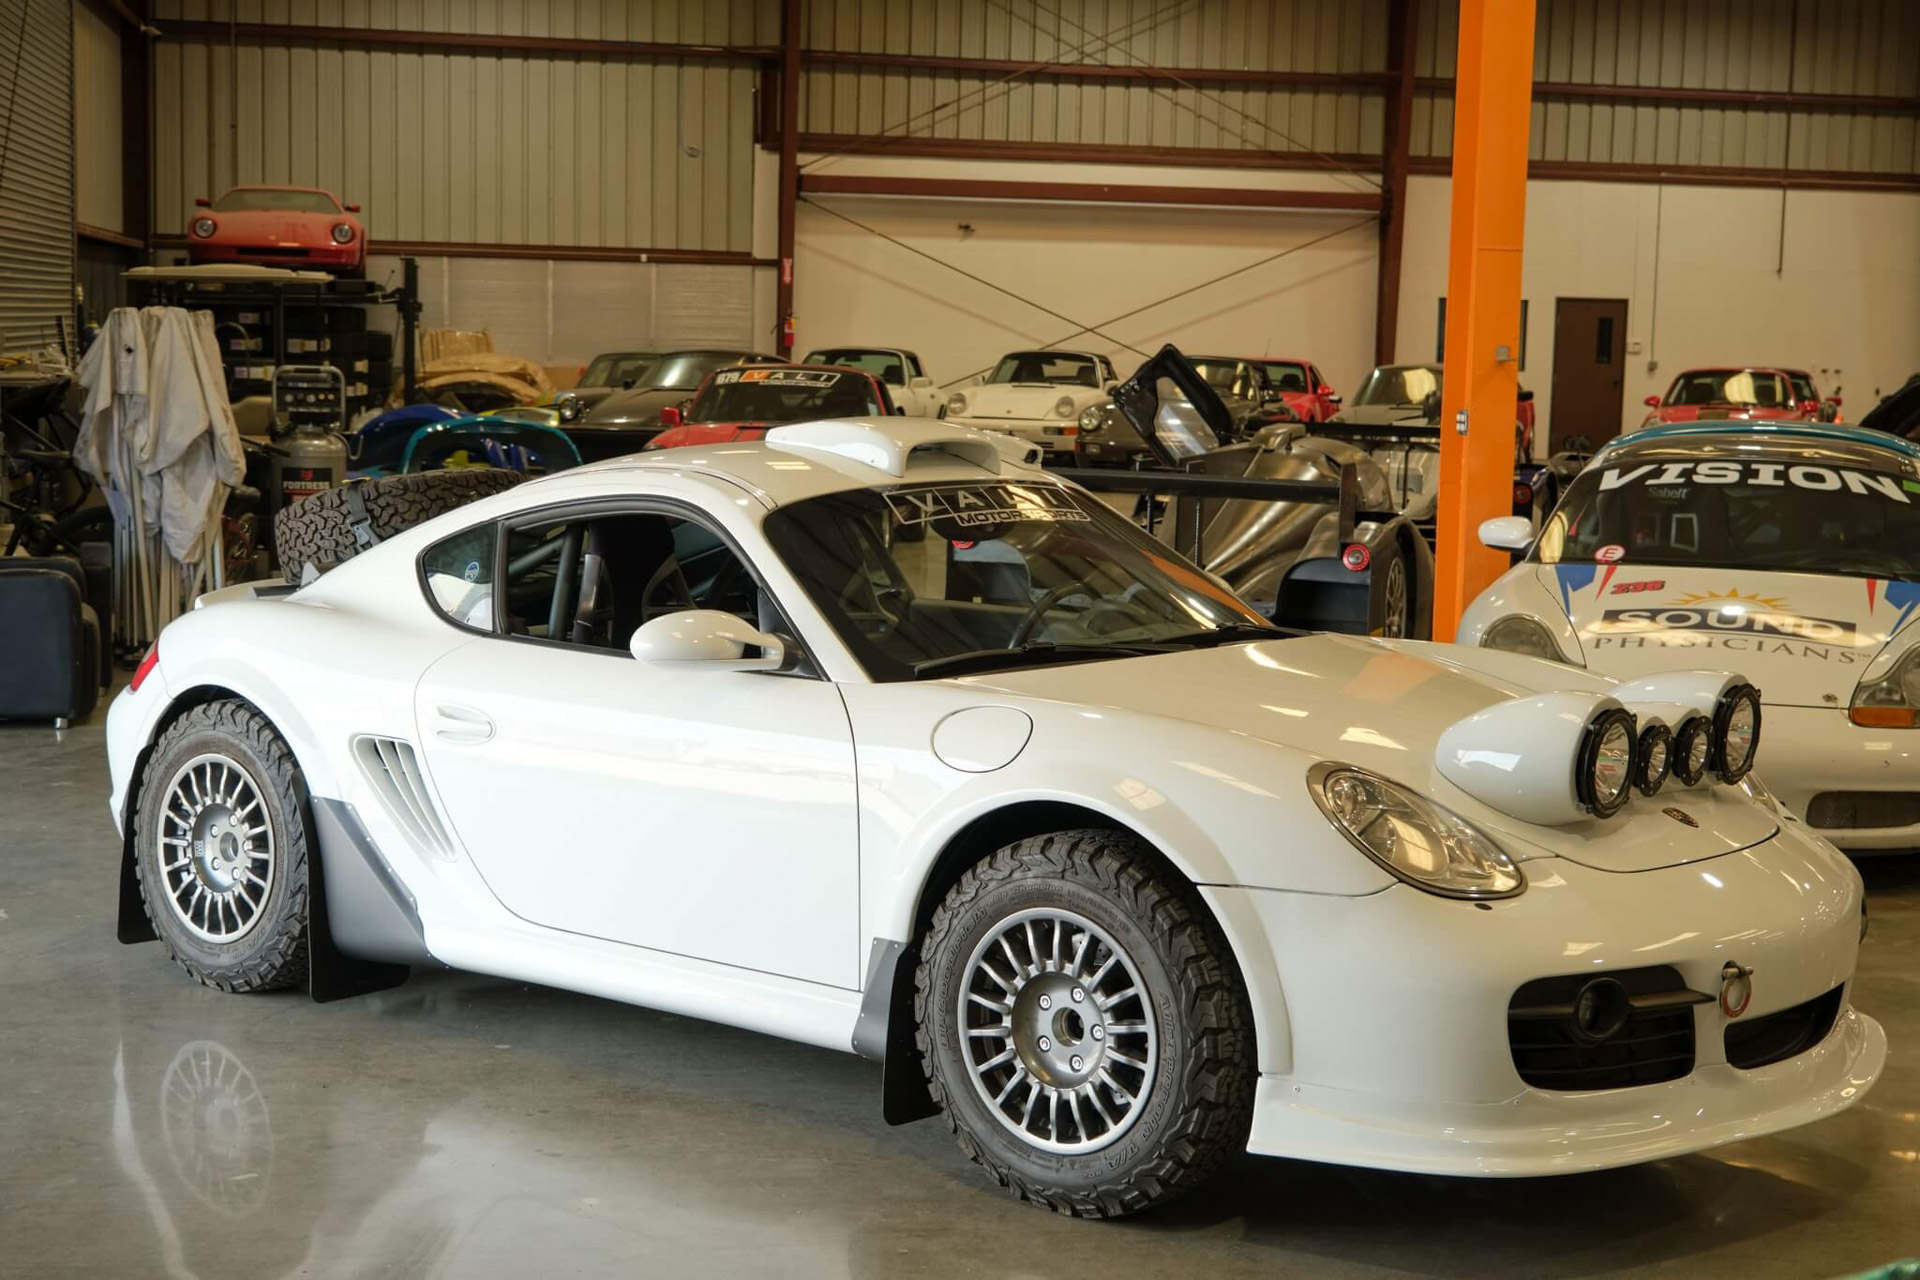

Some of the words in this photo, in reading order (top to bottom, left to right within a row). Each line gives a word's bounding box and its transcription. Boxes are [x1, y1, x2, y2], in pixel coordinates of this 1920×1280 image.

[752, 371, 828, 381] VALI
[283, 481, 330, 489] FORTRESS
[1599, 461, 1911, 504] VISION
[904, 488, 1059, 511] VALI
[1648, 487, 1691, 500] Sabelt
[1617, 610, 1845, 640] SOUND
